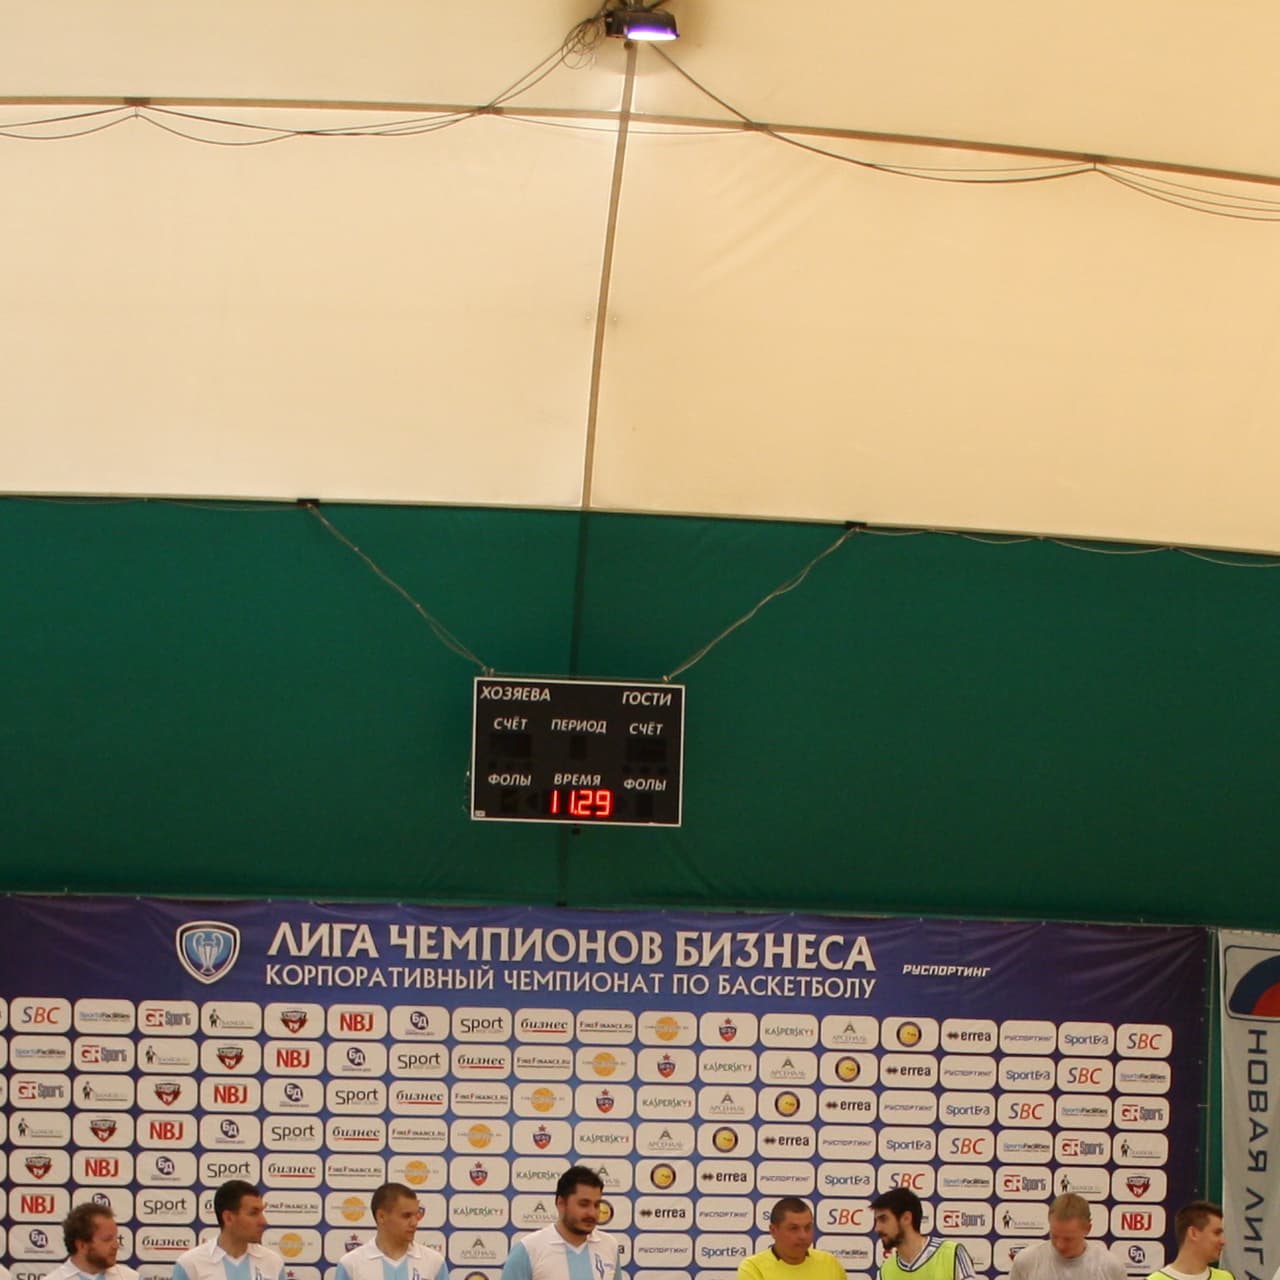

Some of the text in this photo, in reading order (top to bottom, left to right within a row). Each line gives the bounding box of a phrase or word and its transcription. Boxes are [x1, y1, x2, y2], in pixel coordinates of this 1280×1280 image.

[480, 686, 551, 702] ХОЗЯЕВА
[622, 691, 672, 706] ГОСТИ
[493, 716, 528, 731] СЧЁТ
[551, 719, 607, 735] ПЕРИОД
[629, 721, 663, 736] СЧЁТ
[487, 773, 531, 786] ФОЛЫ
[553, 773, 601, 786] ВРЕМЯ
[623, 778, 666, 791] ФОЛЫ
[267, 921, 876, 971] ЛИГА ЧЕМПИОНОВ БИЗНЕСА
[902, 964, 991, 977] РУСПОРТИНГ
[266, 964, 877, 998] КОРПОРАТИВНЫЙ ЧЕМПИОНАТ ПО БАСКЕТБОЛУ
[21, 1006, 60, 1024] SBC
[339, 1012, 373, 1032] NBJ
[520, 1017, 567, 1029] бизнес
[460, 1015, 503, 1033] Sport
[960, 1031, 991, 1041] errea
[1126, 1032, 1161, 1050] SBC
[276, 1048, 310, 1068] NBJ
[397, 1051, 440, 1069] Sport
[457, 1053, 505, 1065] бизнес
[899, 1066, 931, 1076] errea
[1067, 1066, 1102, 1084] SBC
[213, 1084, 247, 1104] NBJ
[335, 1087, 378, 1105] Sport
[396, 1089, 443, 1101] бизнес
[1247, 1029, 1268, 1172] НОВАЯ
[839, 1100, 871, 1111] errea
[1008, 1102, 1044, 1119] SBC
[149, 1120, 183, 1140] NBJ
[271, 1123, 314, 1141] Sport
[332, 1125, 380, 1137] бизнес
[777, 1136, 809, 1146] errea
[949, 1137, 985, 1154] SBC
[84, 1157, 119, 1177] NBJ
[206, 1160, 250, 1178] Sport
[268, 1162, 315, 1174] бизнес
[715, 1172, 747, 1182] errea
[887, 1171, 924, 1189] SBC
[20, 1194, 55, 1214] NBJ
[143, 1197, 187, 1215] Sport
[654, 1208, 686, 1218] errea
[827, 1208, 863, 1225] SBC
[1120, 1212, 1152, 1231] NBJ
[141, 1235, 190, 1246] бизнес
